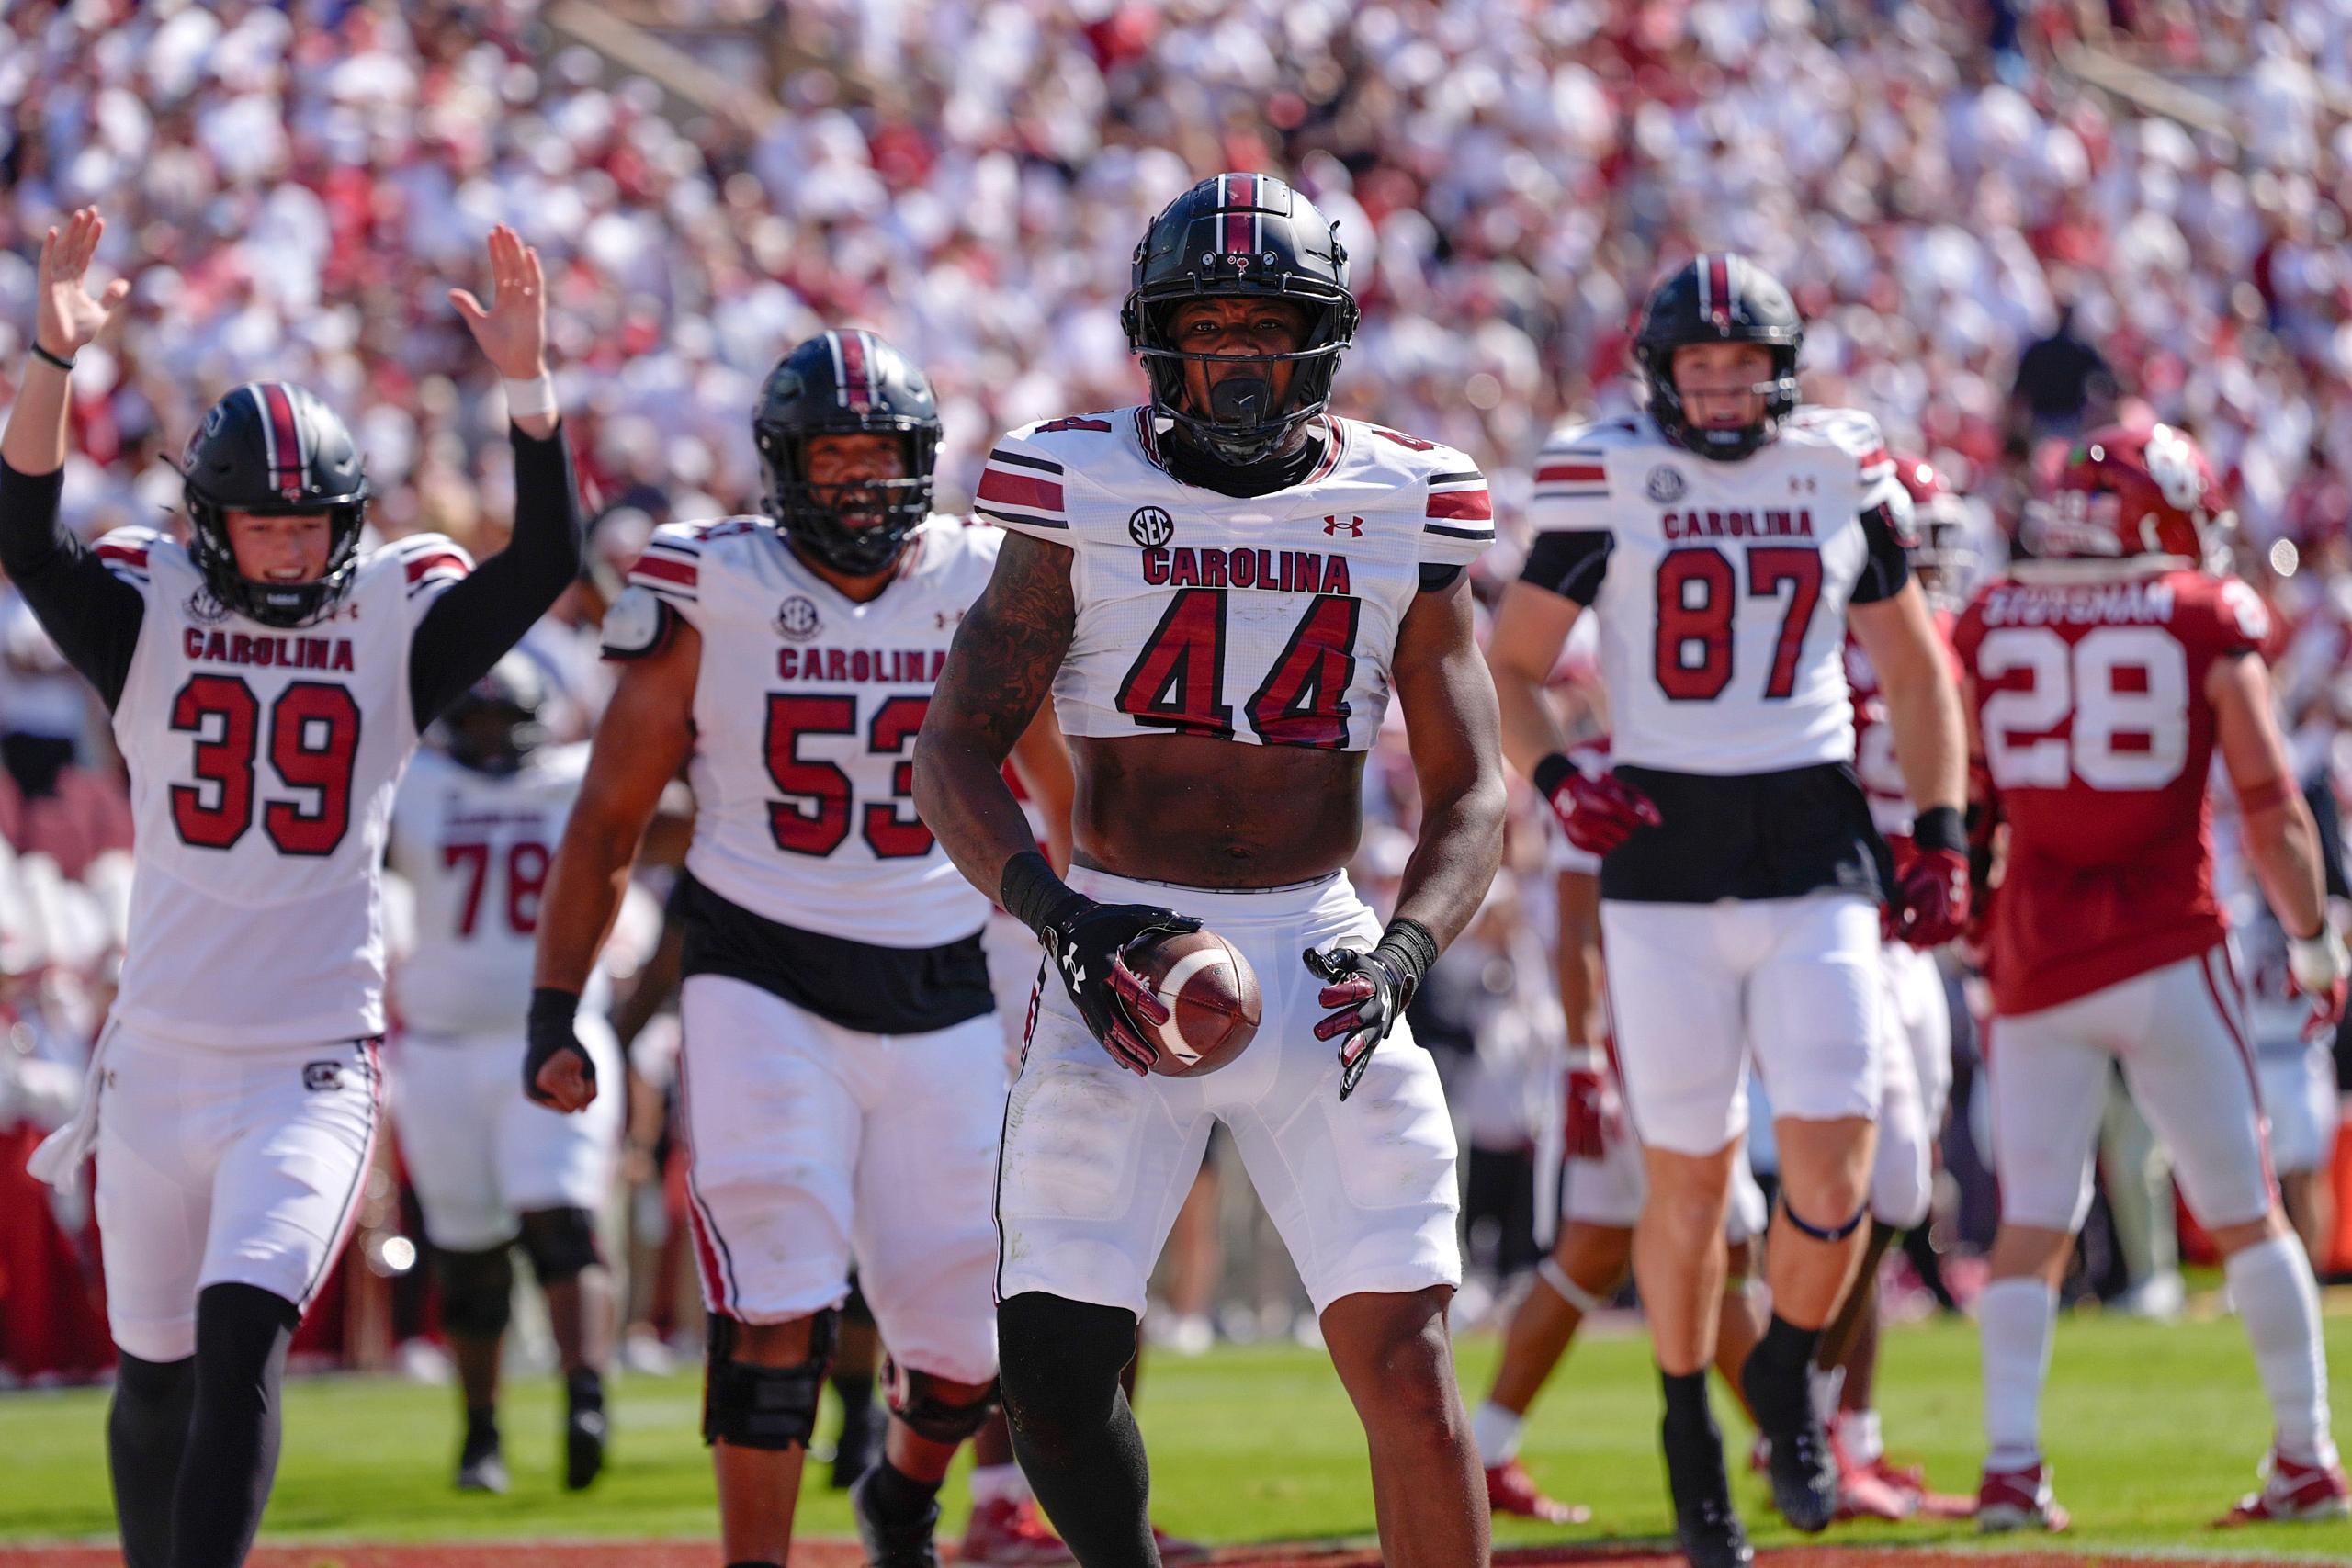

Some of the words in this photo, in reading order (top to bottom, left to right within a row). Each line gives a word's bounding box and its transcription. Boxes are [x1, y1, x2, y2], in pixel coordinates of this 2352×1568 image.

[1130, 507, 1173, 547] SEC
[1143, 547, 1350, 594] CAROLINA
[1663, 511, 1814, 539] CAROLINA
[185, 627, 355, 671] CAROLINA
[1655, 547, 1823, 700] 87
[1981, 581, 2175, 626] STUTSMAN
[1114, 588, 1361, 749] 44
[1977, 626, 2190, 791] 28
[169, 673, 362, 856] 39
[763, 693, 936, 859] 53
[443, 841, 550, 938] 78
